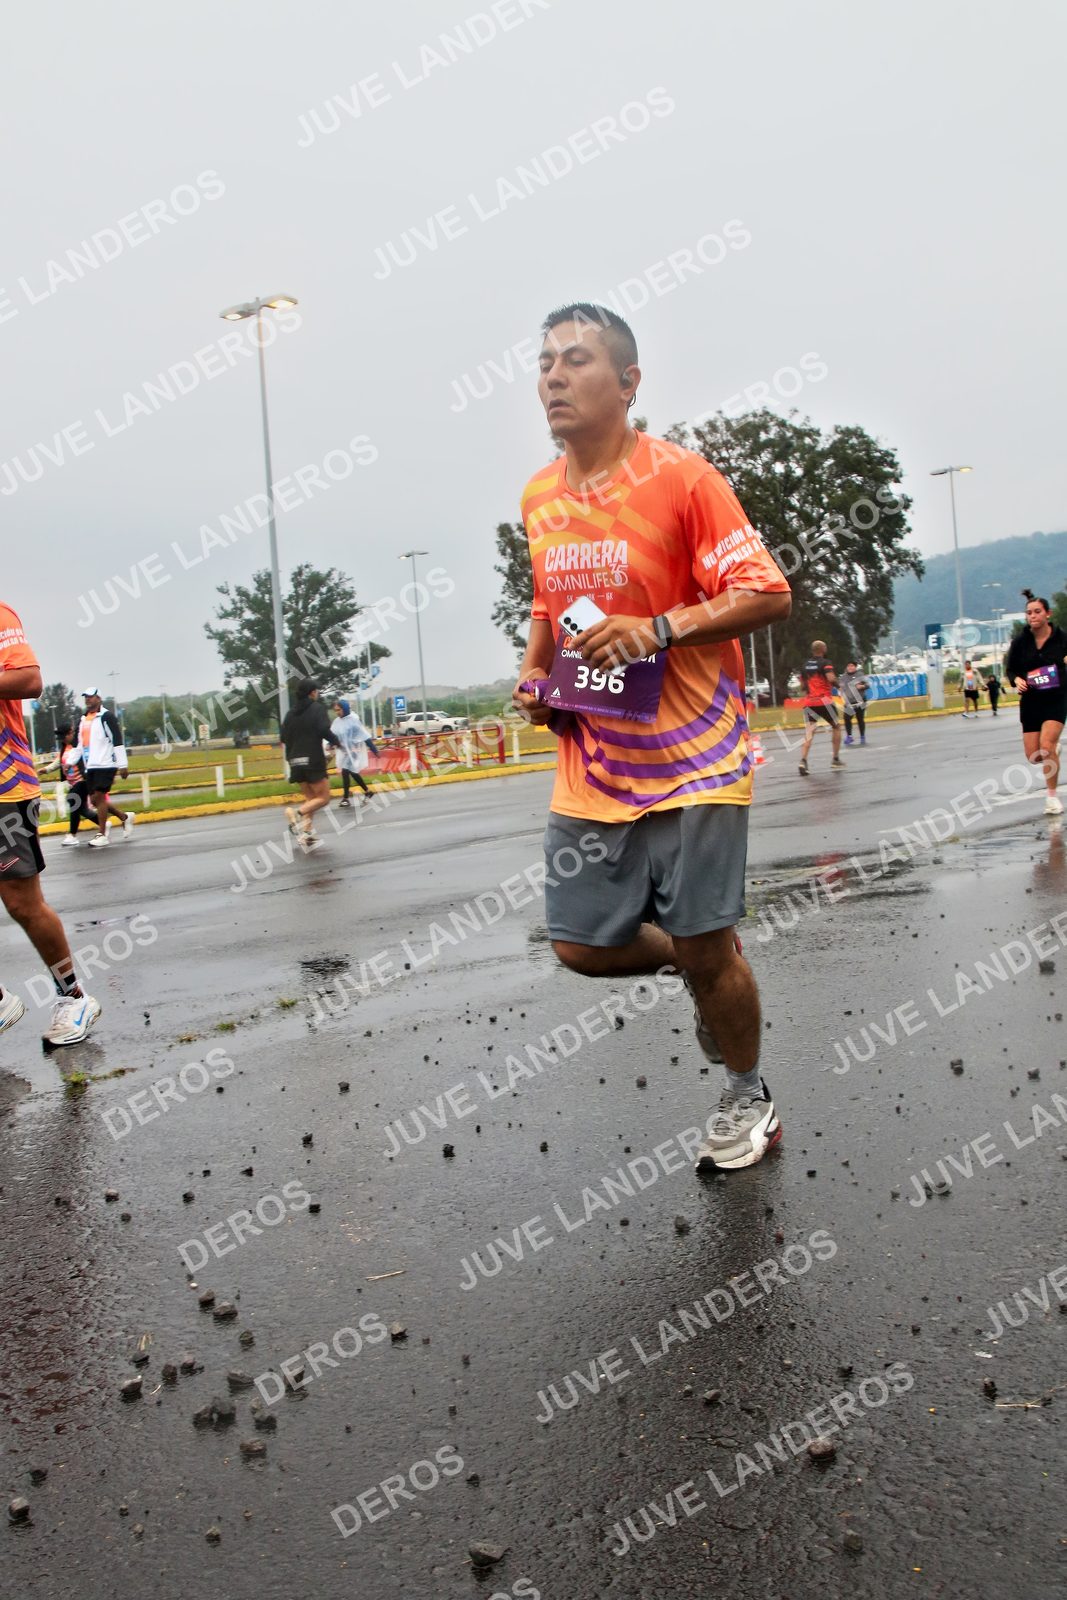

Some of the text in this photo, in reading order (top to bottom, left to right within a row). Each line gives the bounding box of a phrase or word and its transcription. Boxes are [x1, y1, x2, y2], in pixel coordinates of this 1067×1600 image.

[545, 540, 628, 573] CARRERA
[546, 572, 610, 592] OMNILIFE
[928, 634, 938, 646] E
[574, 665, 626, 694] 396
[1034, 675, 1050, 685] 155
